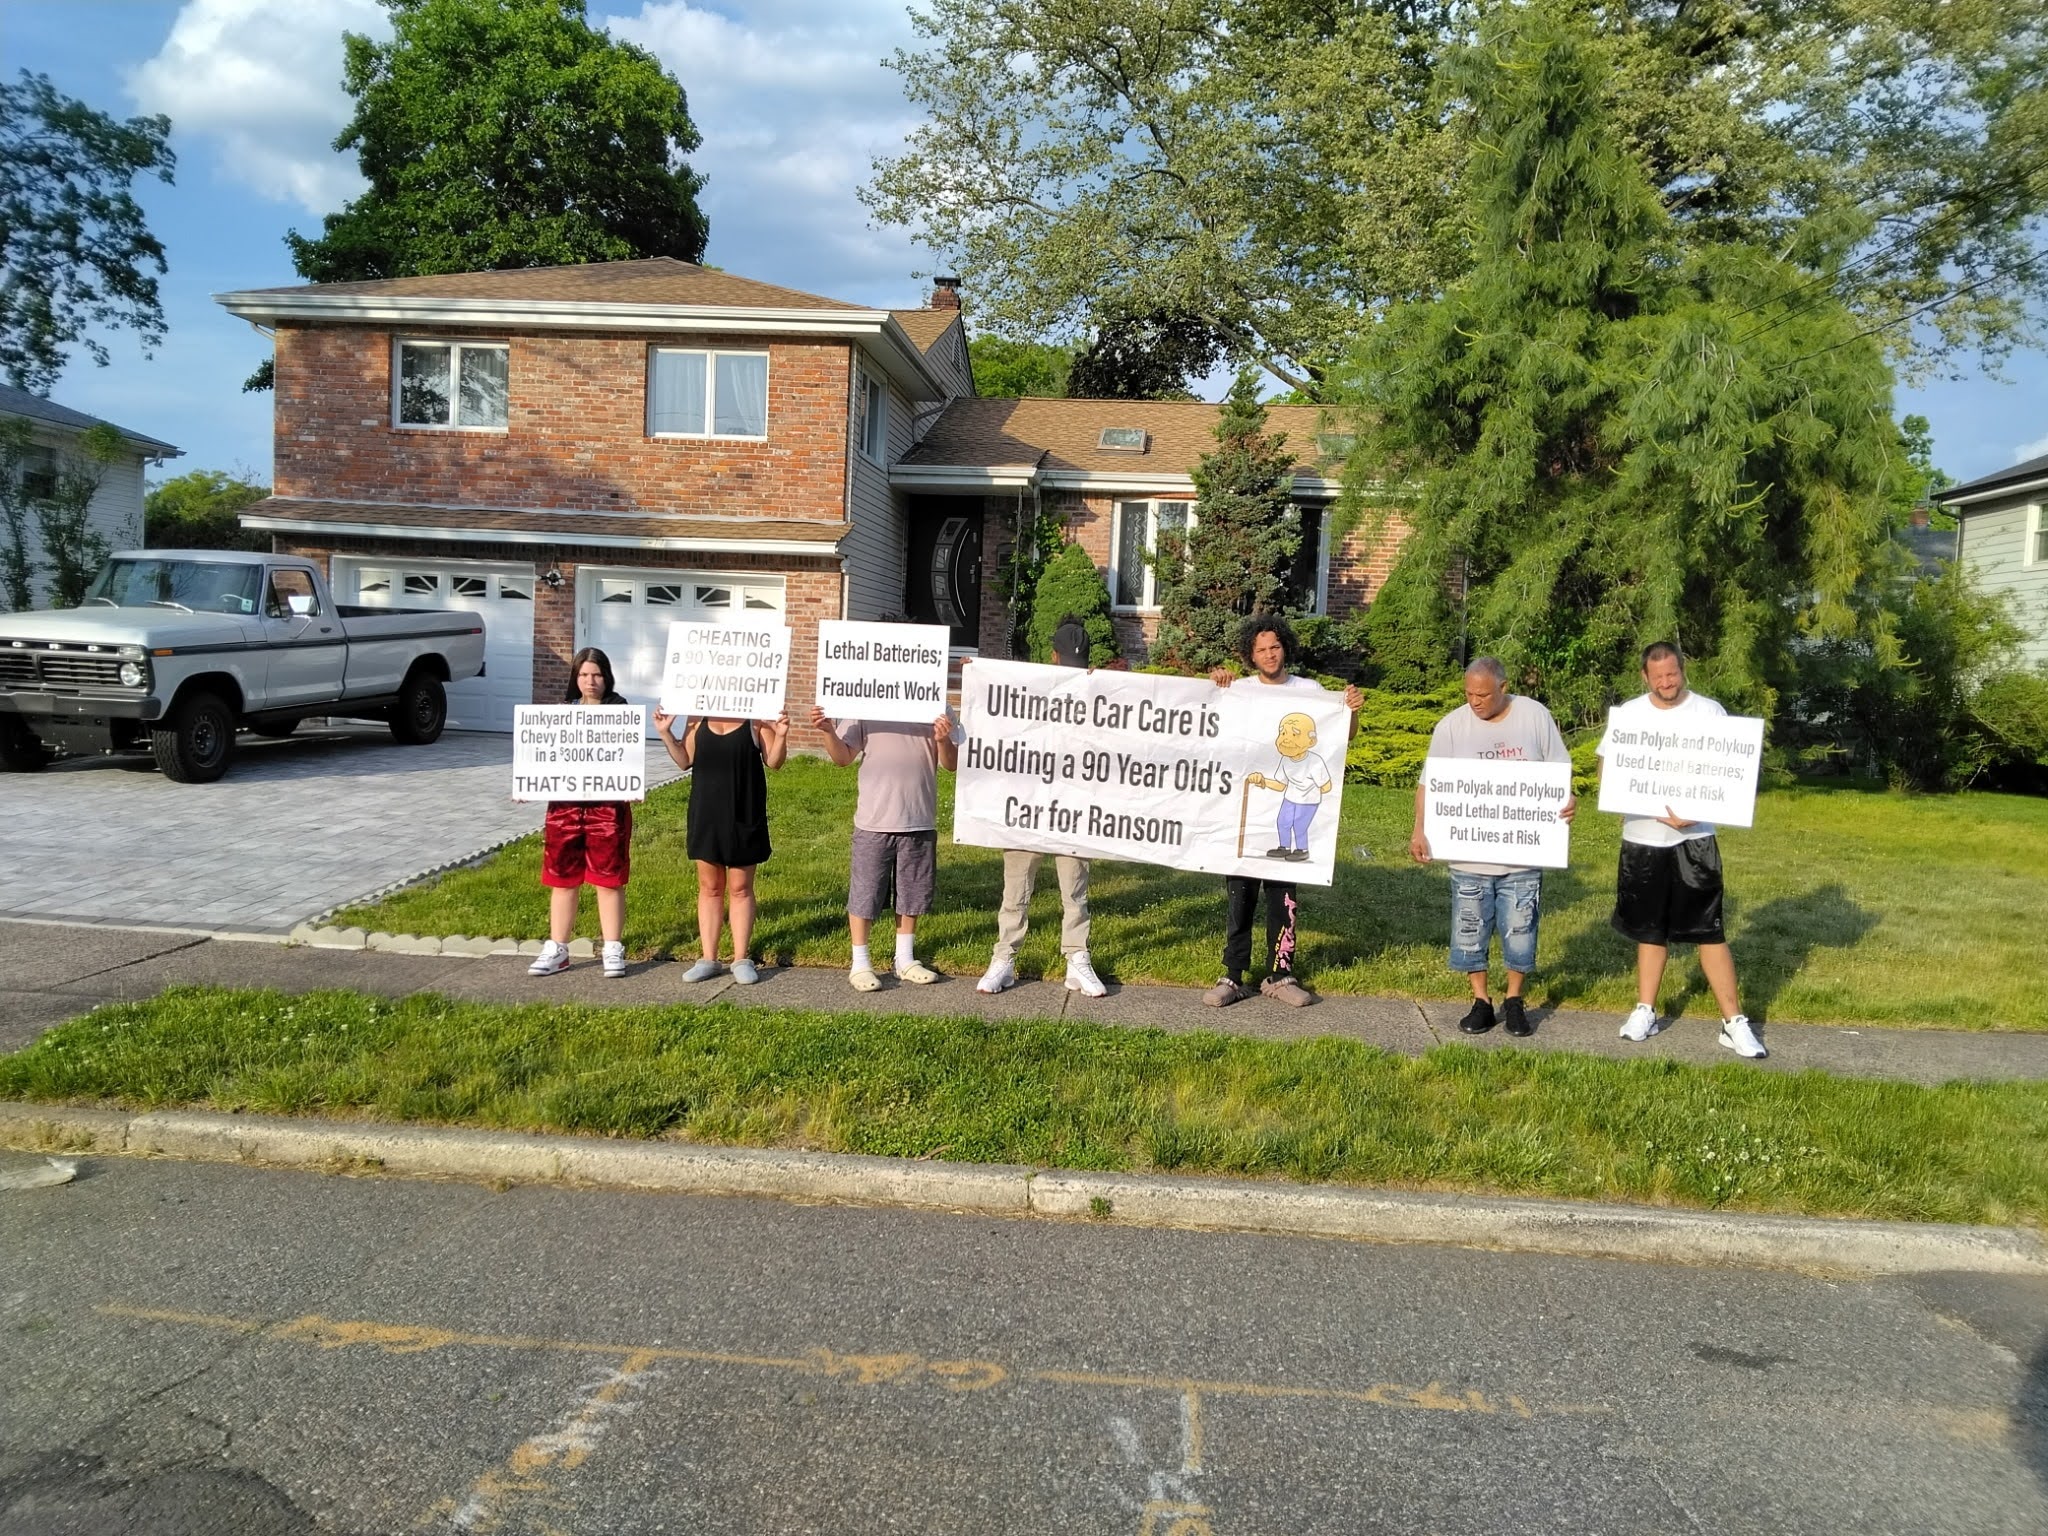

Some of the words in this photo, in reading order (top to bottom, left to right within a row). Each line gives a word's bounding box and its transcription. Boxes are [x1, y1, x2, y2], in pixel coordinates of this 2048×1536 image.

[688, 630, 771, 648] CHEATING
[672, 652, 680, 664] a
[685, 650, 703, 664] 90
[709, 650, 741, 666] Year
[747, 652, 782, 669] Old?
[825, 640, 869, 661] Lethal
[874, 643, 942, 667] Batteries;
[675, 674, 780, 694] DOWNRIGHT
[823, 677, 900, 699] Fraudulent
[904, 681, 940, 701] Work
[695, 695, 754, 712] EVIL!!!!
[987, 684, 1086, 725] Ultimate
[1093, 695, 1133, 729] Car
[1138, 699, 1193, 736] Care
[1199, 703, 1220, 738] is
[520, 711, 572, 728] Junkyard
[576, 711, 640, 725] Flammable
[521, 729, 556, 746] Chevy
[560, 730, 583, 743] Bolt
[587, 729, 639, 743] Batteries
[1612, 729, 1637, 745] Sam
[1640, 731, 1678, 751] Polyak
[1682, 736, 1704, 750] and
[1707, 737, 1755, 758] Polykup
[536, 748, 546, 762] in
[550, 751, 556, 762] a
[560, 747, 594, 762] $300K
[597, 747, 624, 762] Car?
[1477, 747, 1523, 759] TOMMY
[1616, 754, 1645, 769] Used
[967, 737, 1055, 785] Holding
[1062, 754, 1074, 779] a
[1081, 750, 1111, 783] 90
[1117, 753, 1169, 789] Year
[1174, 759, 1232, 795] Old's
[516, 776, 577, 792] THAT'S
[583, 776, 641, 792] FRAUD
[1430, 778, 1454, 793] Sam
[1457, 780, 1493, 798] Polyak
[1496, 782, 1516, 796] and
[1520, 783, 1565, 802] Polykup
[1629, 779, 1648, 794] Put
[1652, 781, 1681, 797] Lives
[1685, 785, 1696, 799] at
[1700, 786, 1725, 802] Risk
[1005, 796, 1043, 829] Car
[1048, 800, 1082, 834] for
[1088, 805, 1183, 845] Ransom
[1436, 802, 1462, 816] Used
[1466, 803, 1499, 819] Lethal
[1503, 806, 1557, 824] Batteries;
[1450, 826, 1468, 840] Put
[1472, 827, 1500, 843] Lives
[1503, 830, 1513, 844] at
[1517, 830, 1540, 845] Risk
